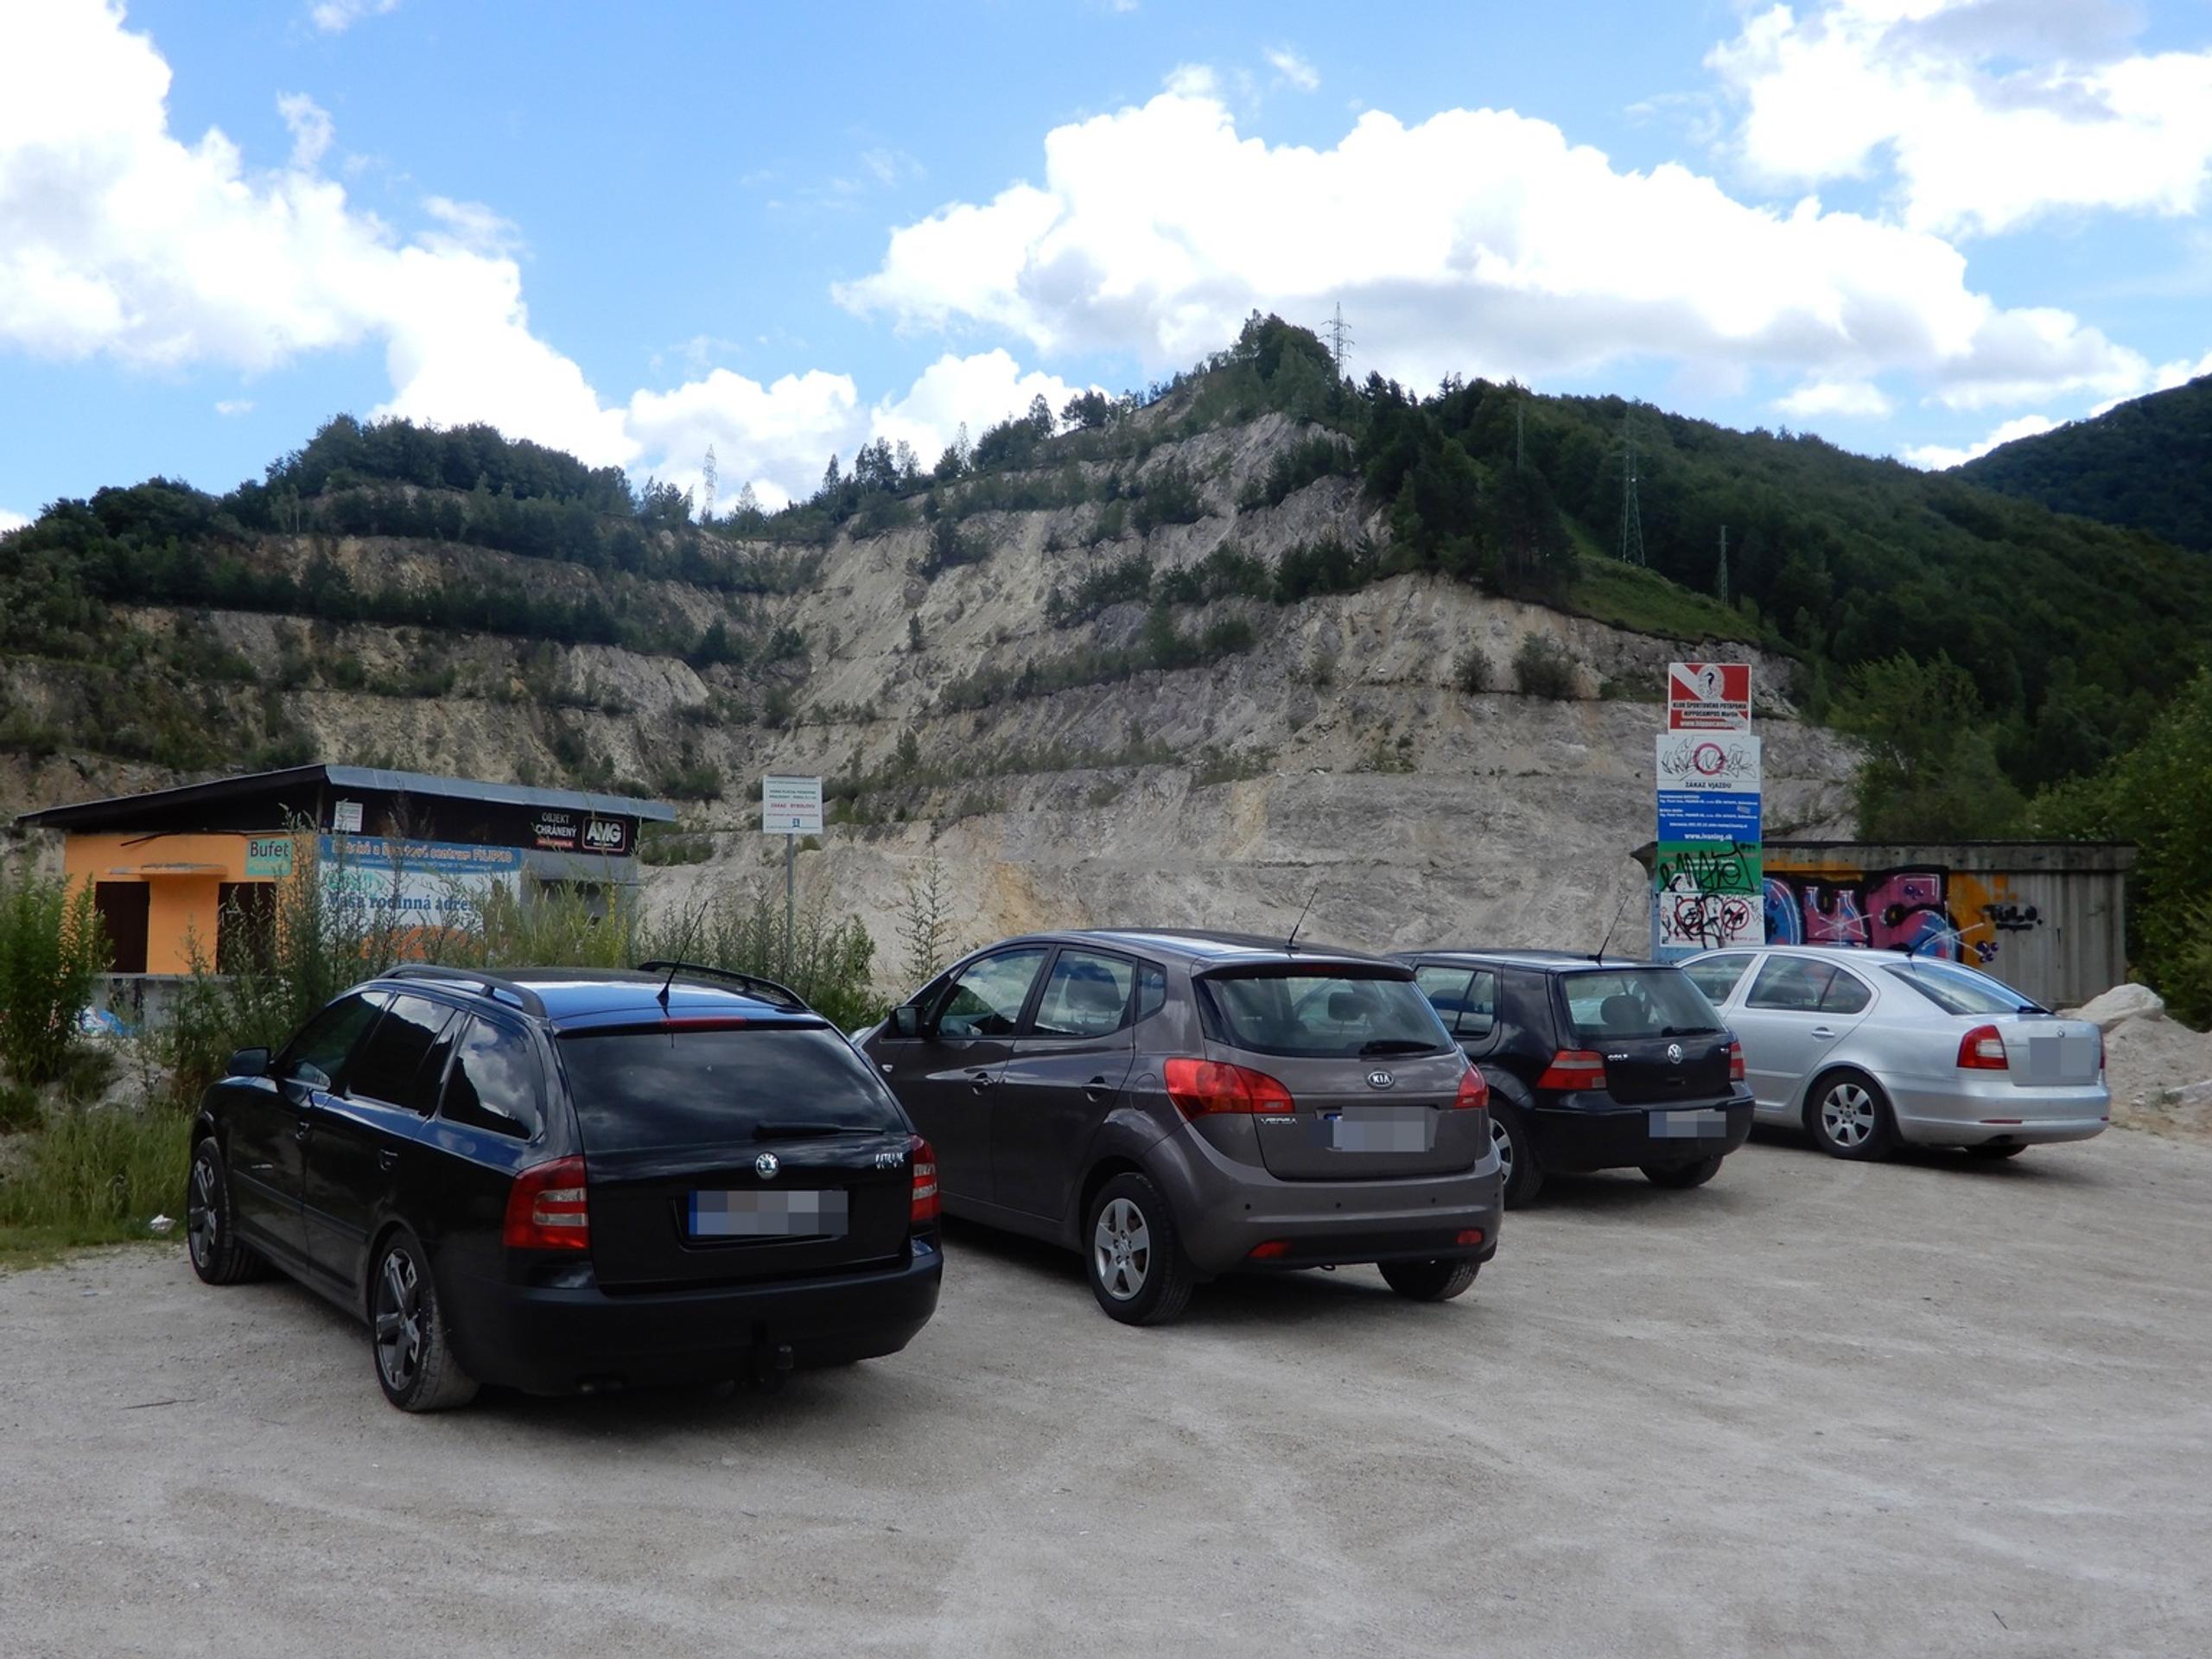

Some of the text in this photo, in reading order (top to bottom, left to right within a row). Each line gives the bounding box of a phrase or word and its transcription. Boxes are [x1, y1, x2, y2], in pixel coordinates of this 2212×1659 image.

[541, 812, 570, 823] OBJEKT
[536, 823, 577, 838] CHRÁNENÝ
[587, 821, 622, 843] AMG
[251, 841, 289, 857] Bufet
[369, 893, 432, 911] rodinná
